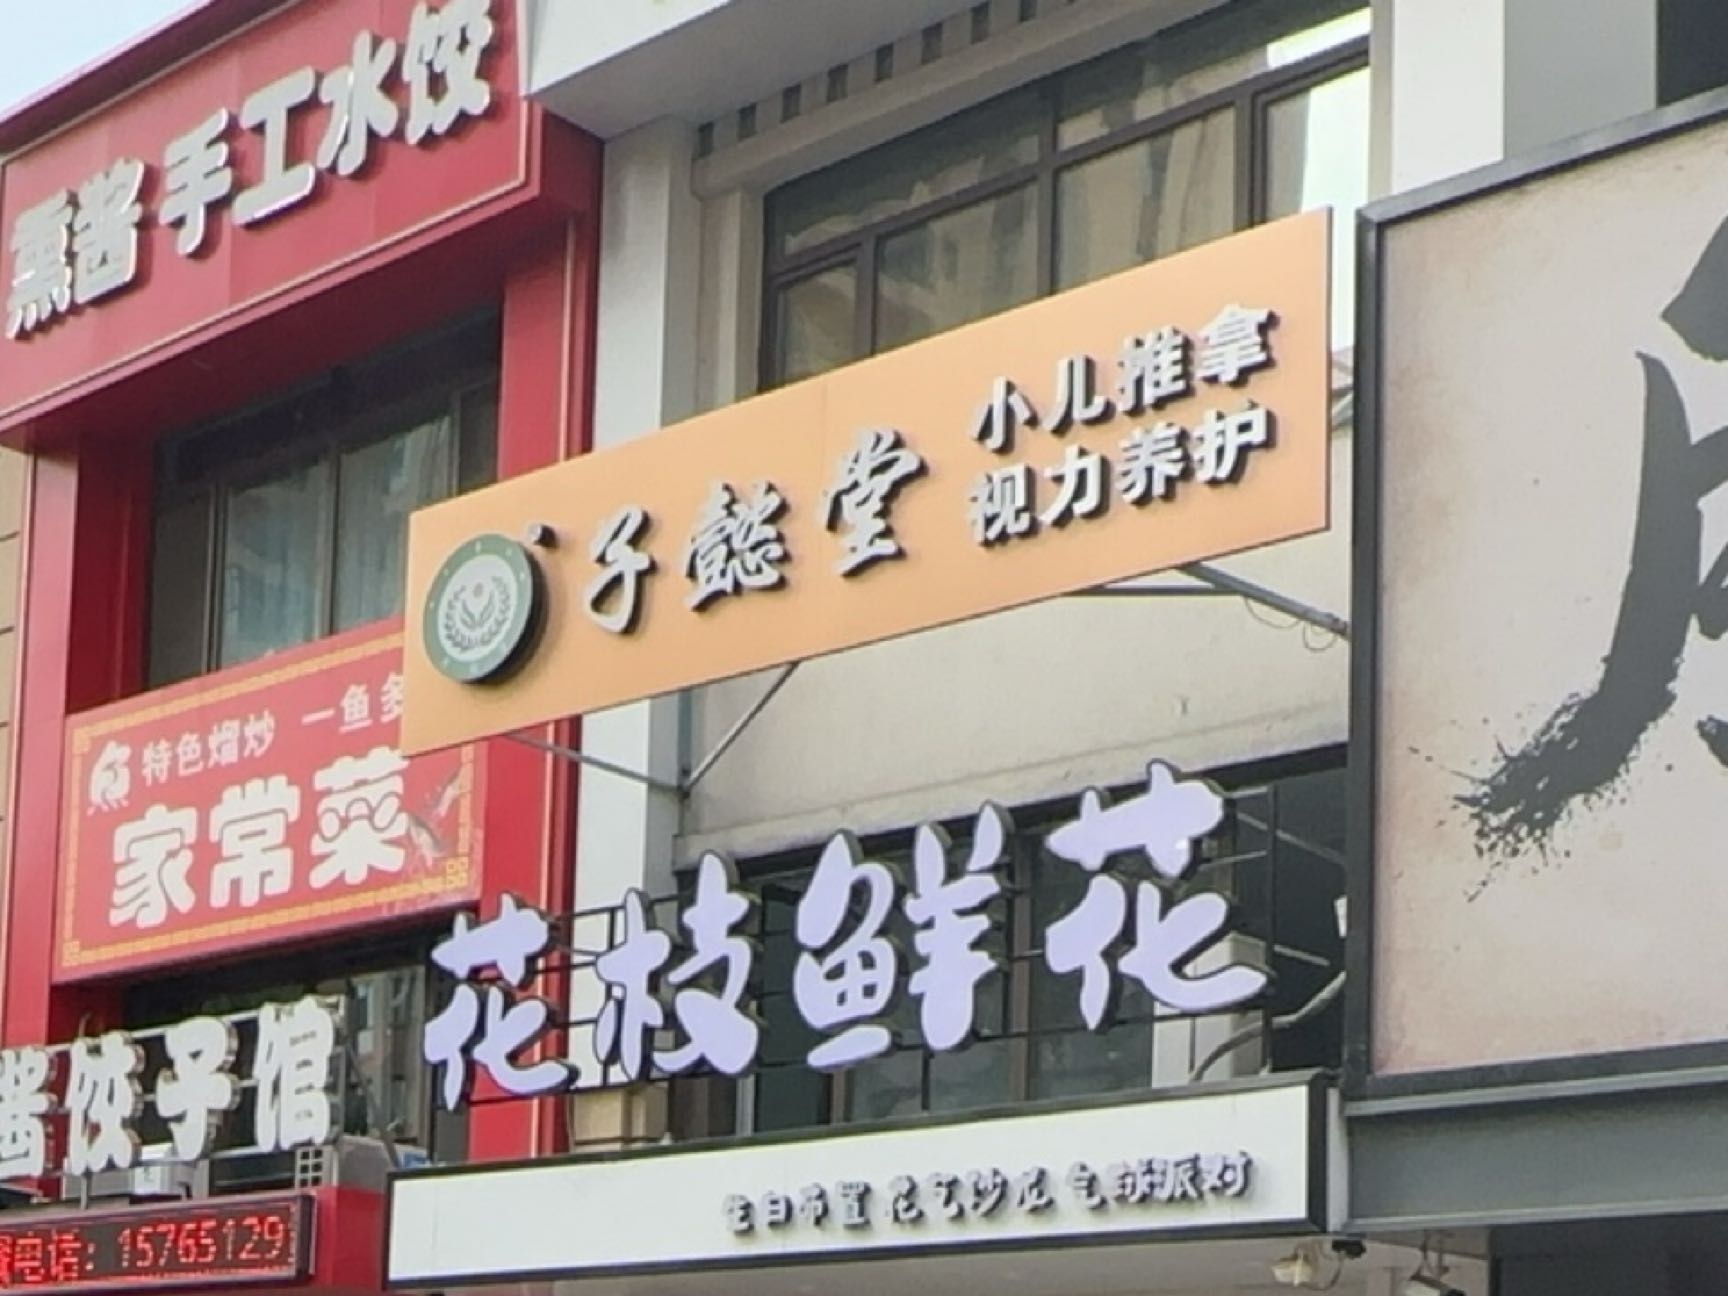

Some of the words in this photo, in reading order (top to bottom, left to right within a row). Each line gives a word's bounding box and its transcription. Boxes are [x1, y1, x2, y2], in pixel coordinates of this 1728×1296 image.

[968, 303, 1273, 453] 小儿推拿
[968, 402, 1271, 546] 视力养护
[108, 746, 411, 929] 家常菜
[424, 758, 1268, 1112] 花枝鲜花
